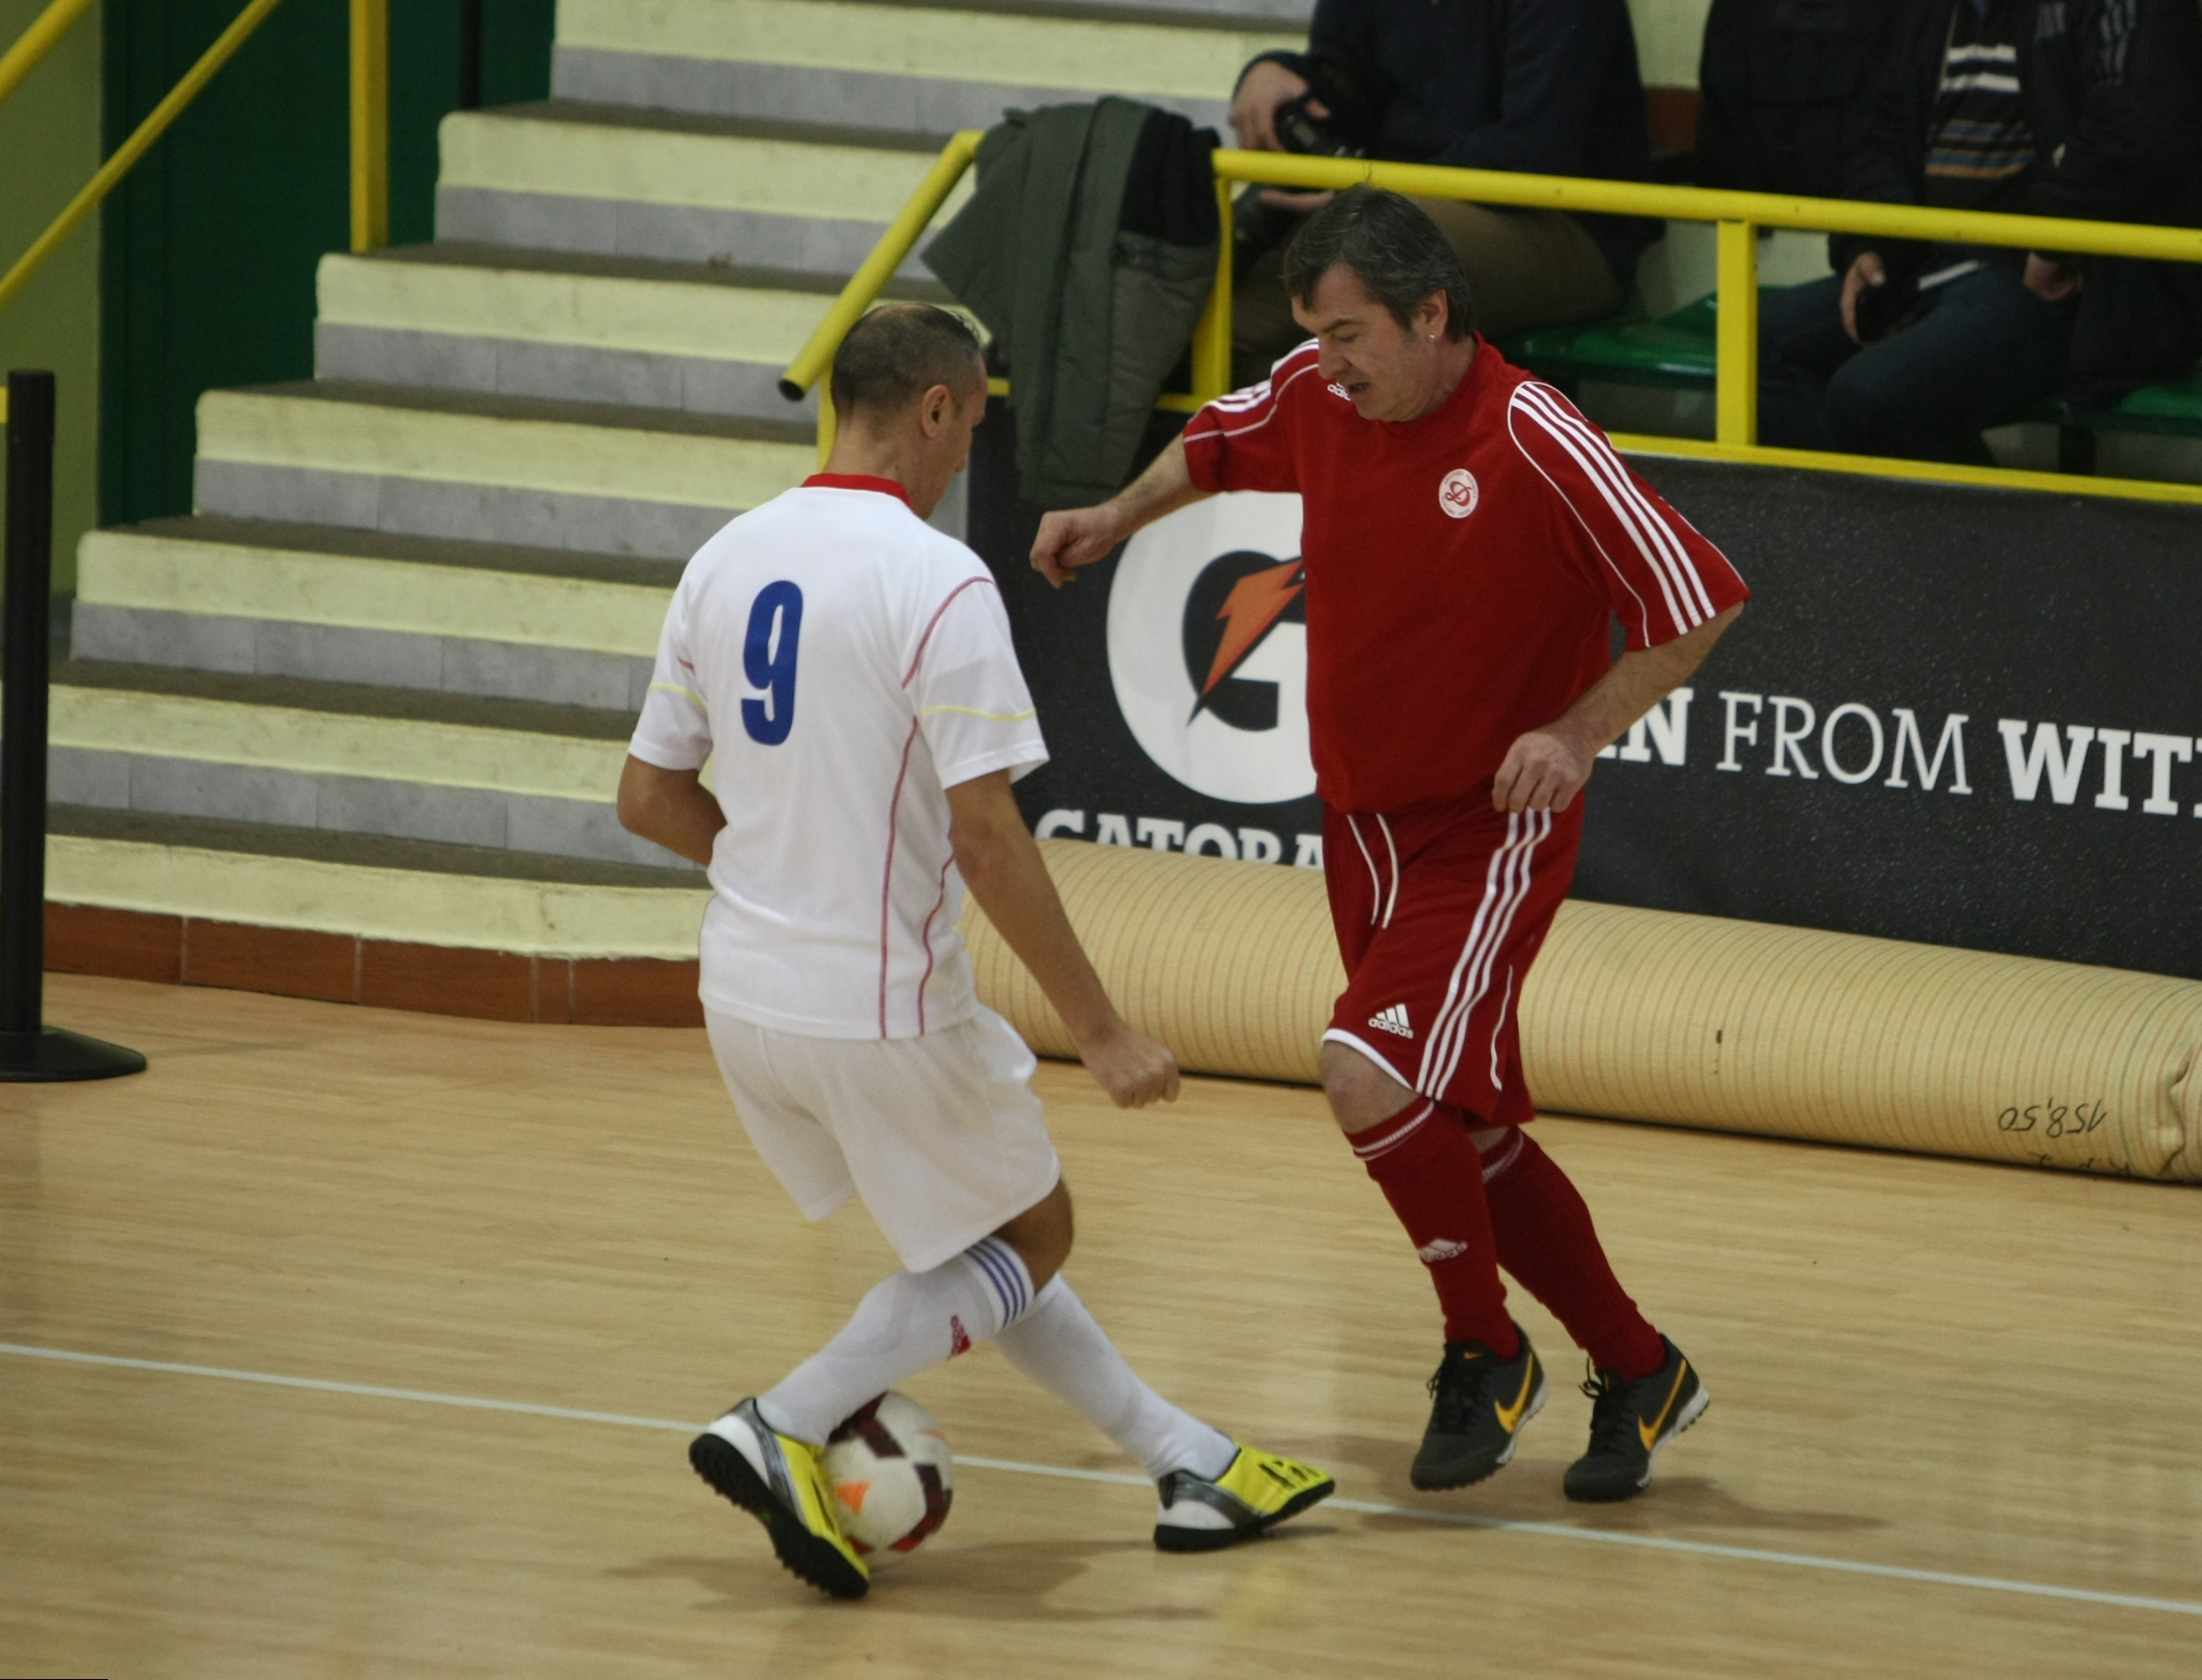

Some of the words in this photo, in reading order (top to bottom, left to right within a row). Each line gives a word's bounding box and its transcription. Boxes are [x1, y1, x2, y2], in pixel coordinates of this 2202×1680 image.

[740, 580, 803, 746] 9
[1596, 687, 1694, 766] N
[1716, 690, 1973, 795] FROM
[1998, 719, 2202, 818] WIT
[1368, 1018, 1414, 1039] adidas
